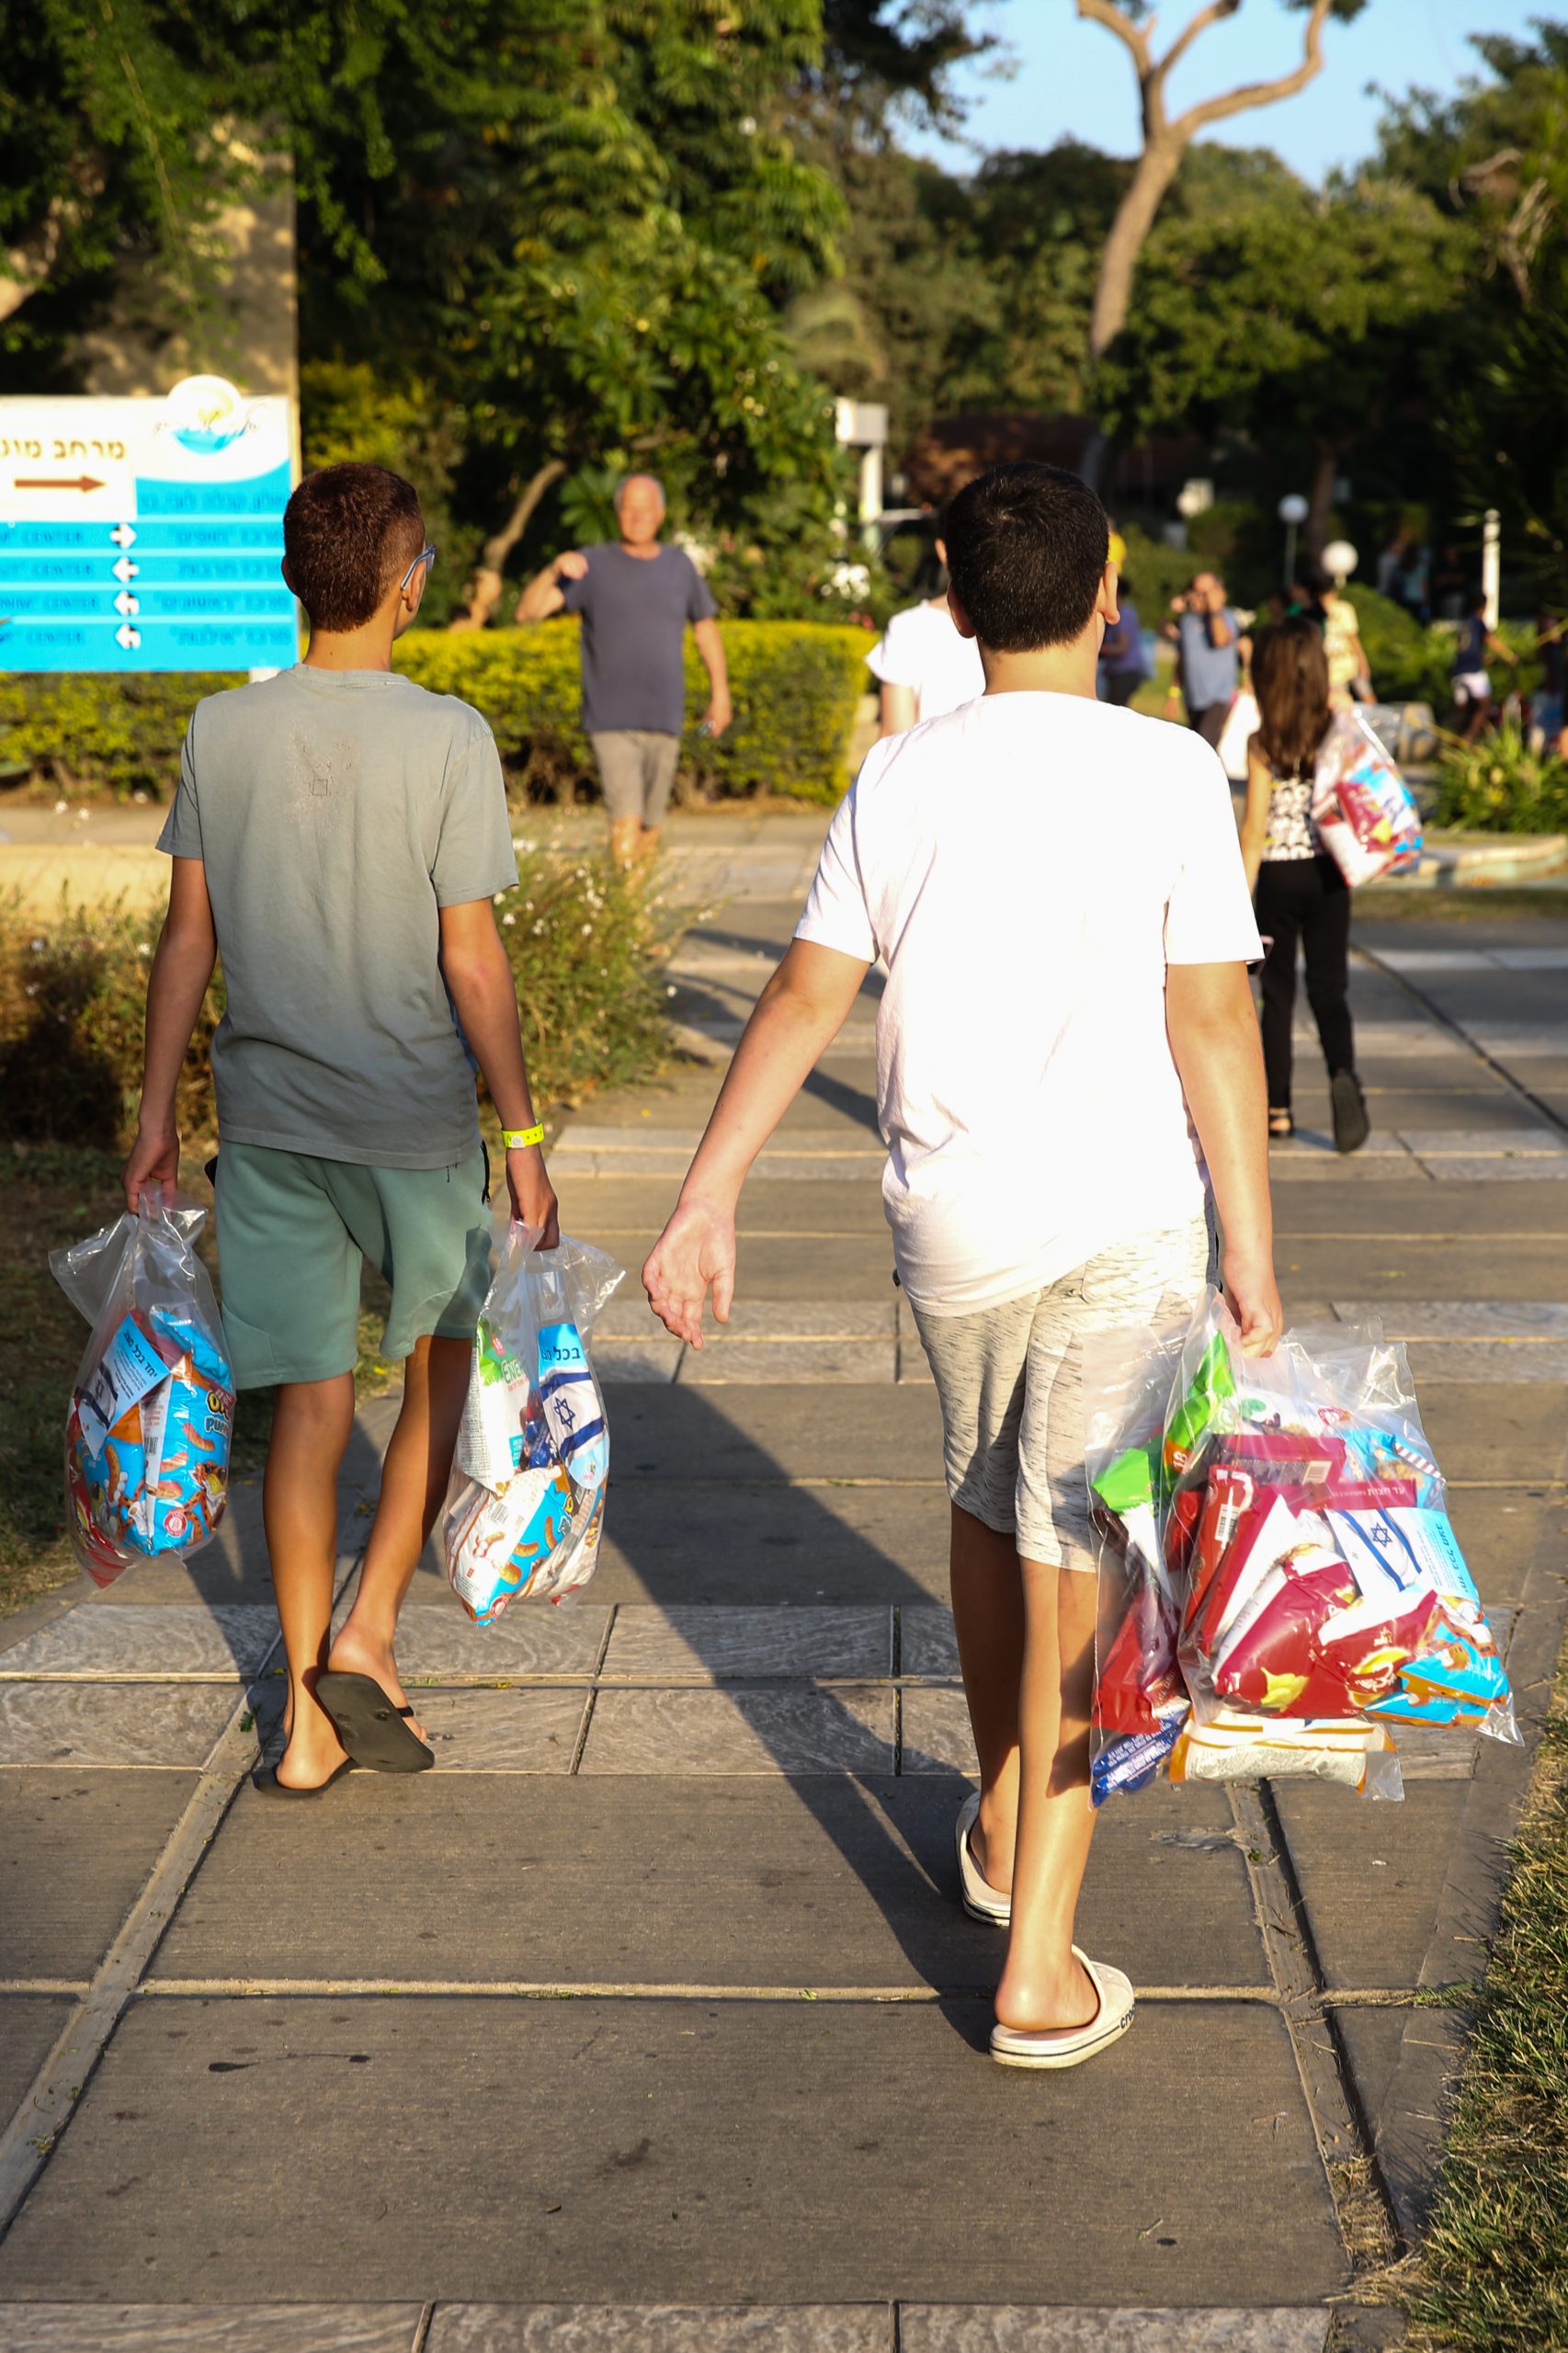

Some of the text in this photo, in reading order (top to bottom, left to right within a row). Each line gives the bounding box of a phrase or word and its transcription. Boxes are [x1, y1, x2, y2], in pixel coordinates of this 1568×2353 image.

[53, 439, 126, 460] מרחב
[131, 1344, 145, 1364] בכל
[553, 1346, 580, 1361] בכל
[144, 1361, 158, 1378] יחד
[1367, 1486, 1391, 1497] חצות
[1392, 1486, 1405, 1495] עד
